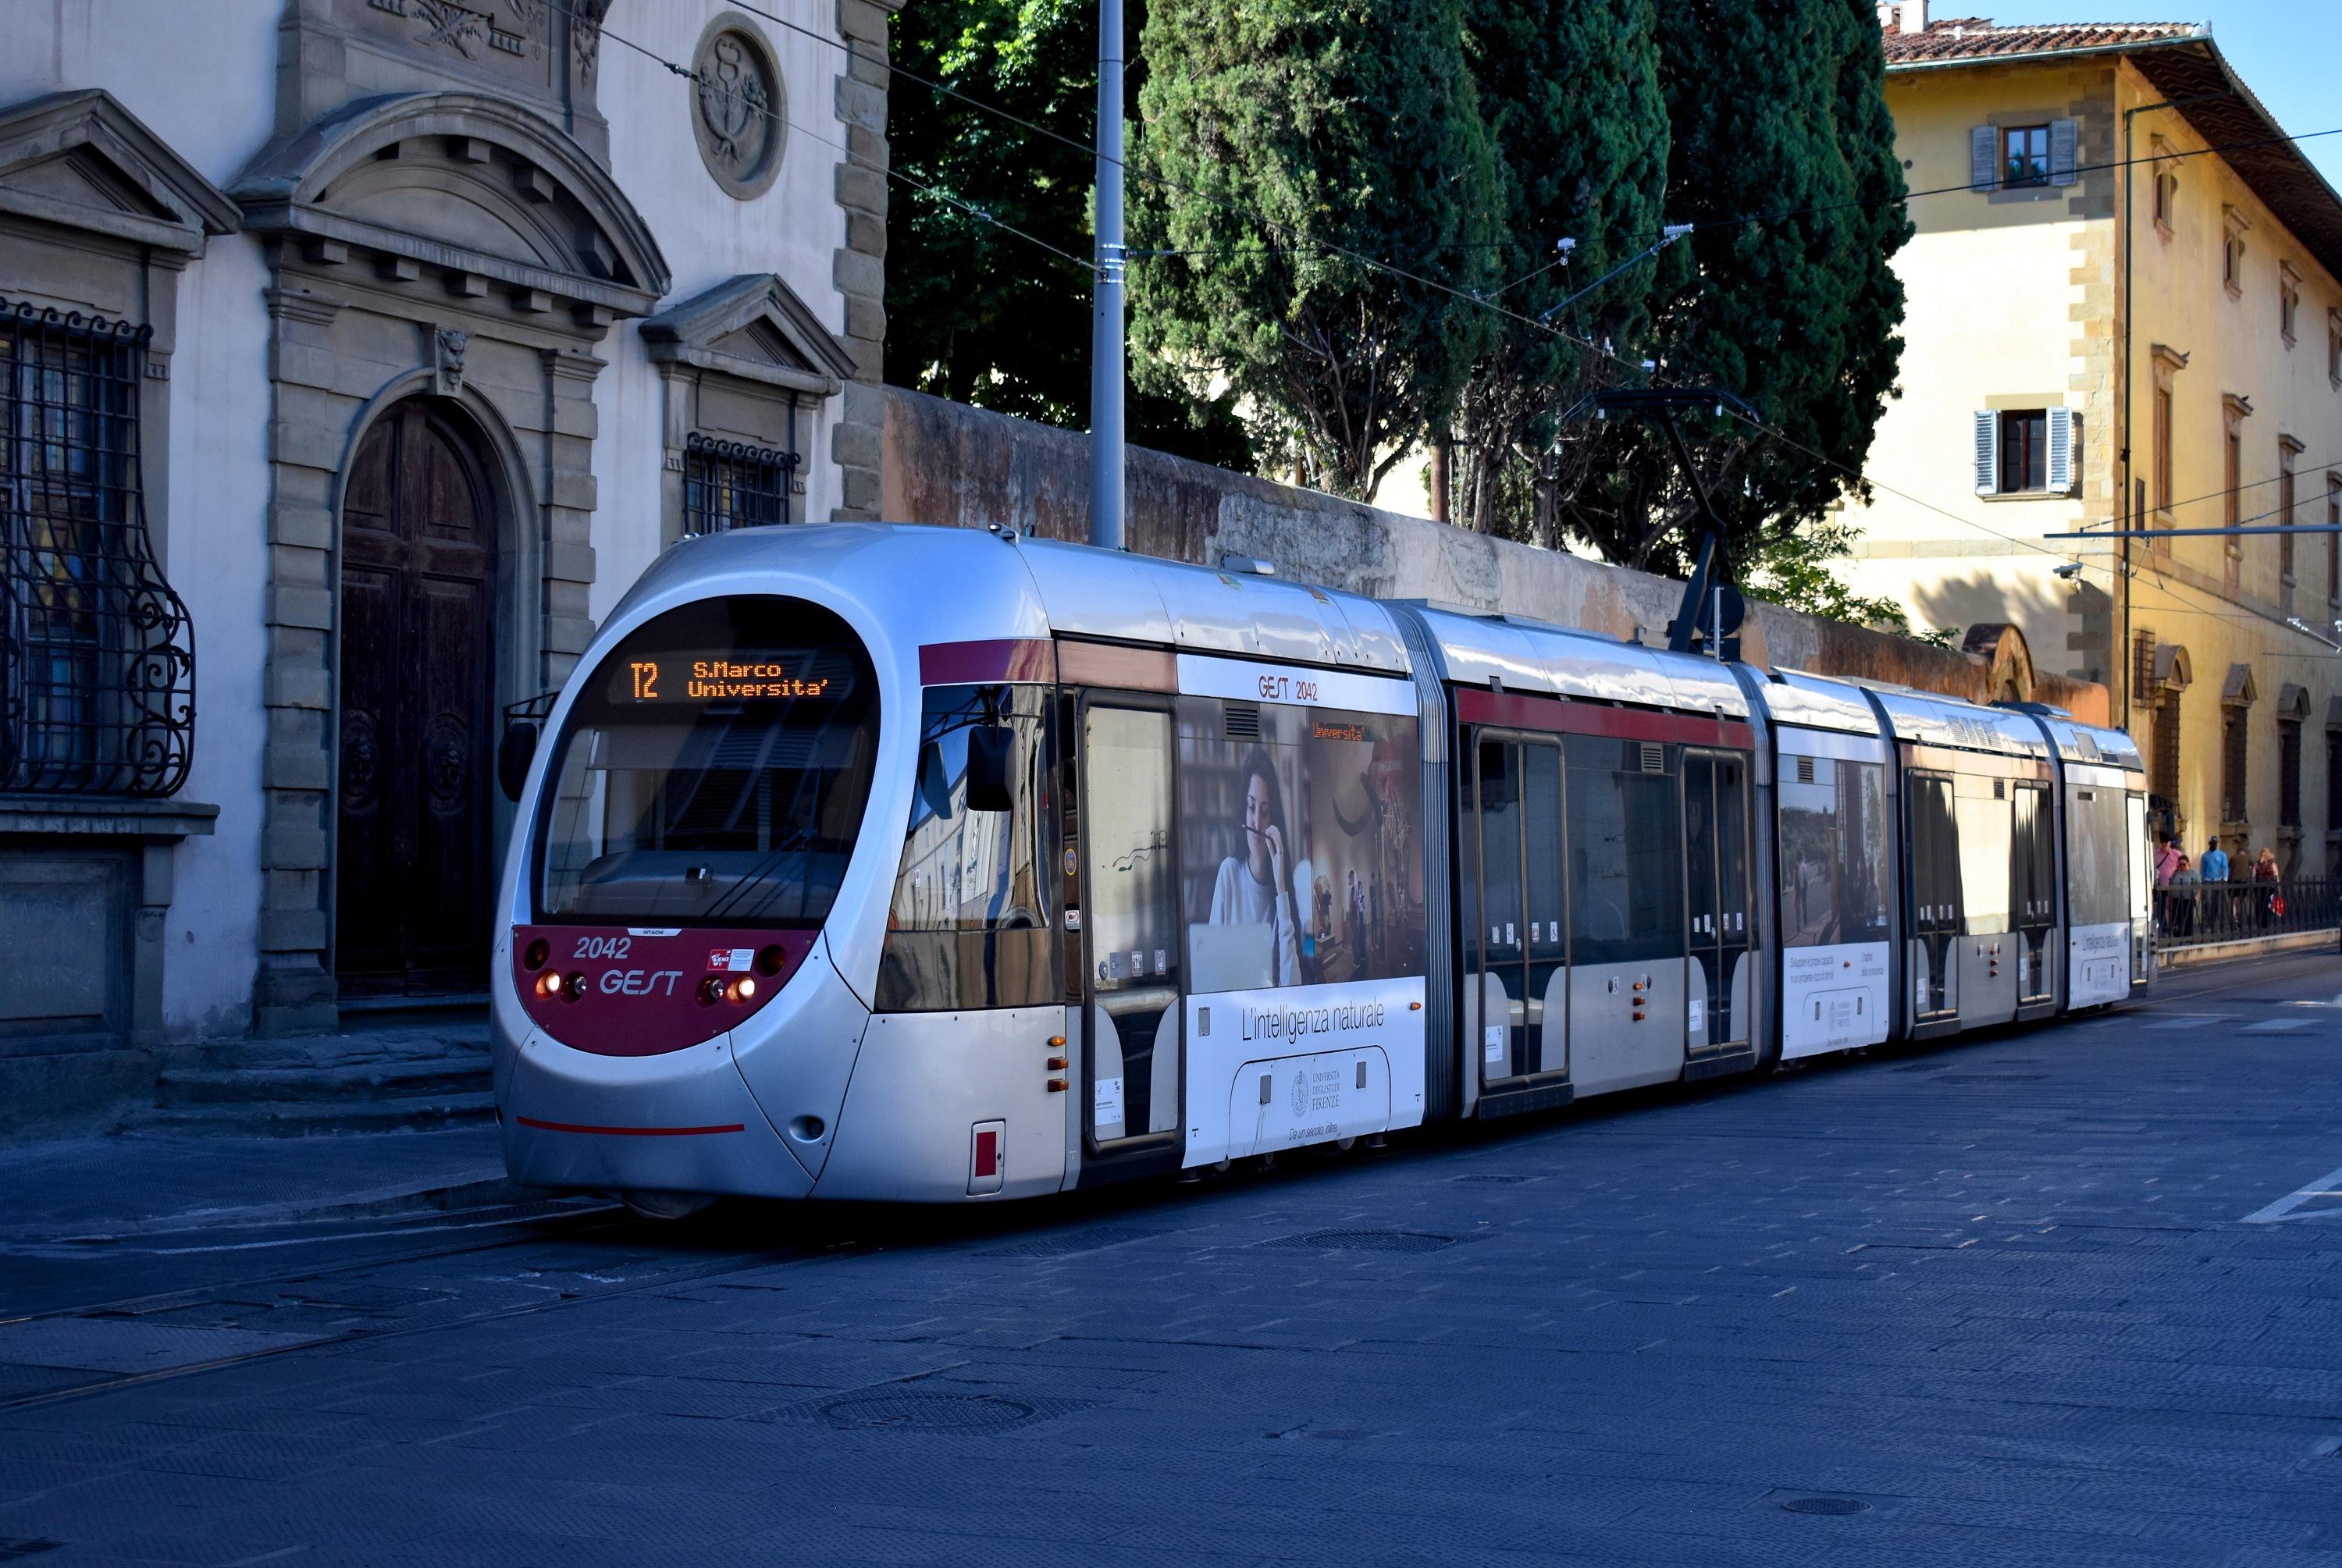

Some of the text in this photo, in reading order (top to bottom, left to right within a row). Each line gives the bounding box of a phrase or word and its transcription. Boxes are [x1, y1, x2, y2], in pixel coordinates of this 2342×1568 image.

[631, 662, 658, 698] T2
[693, 661, 781, 677] S.Marco
[688, 678, 828, 697] Universita'
[1258, 675, 1319, 701] GEST 2042
[573, 937, 632, 959] 2042
[600, 969, 683, 996] GEST
[1242, 996, 1384, 1044] L'intelligenza naturale
[1312, 1094, 1340, 1111] FIRENZE
